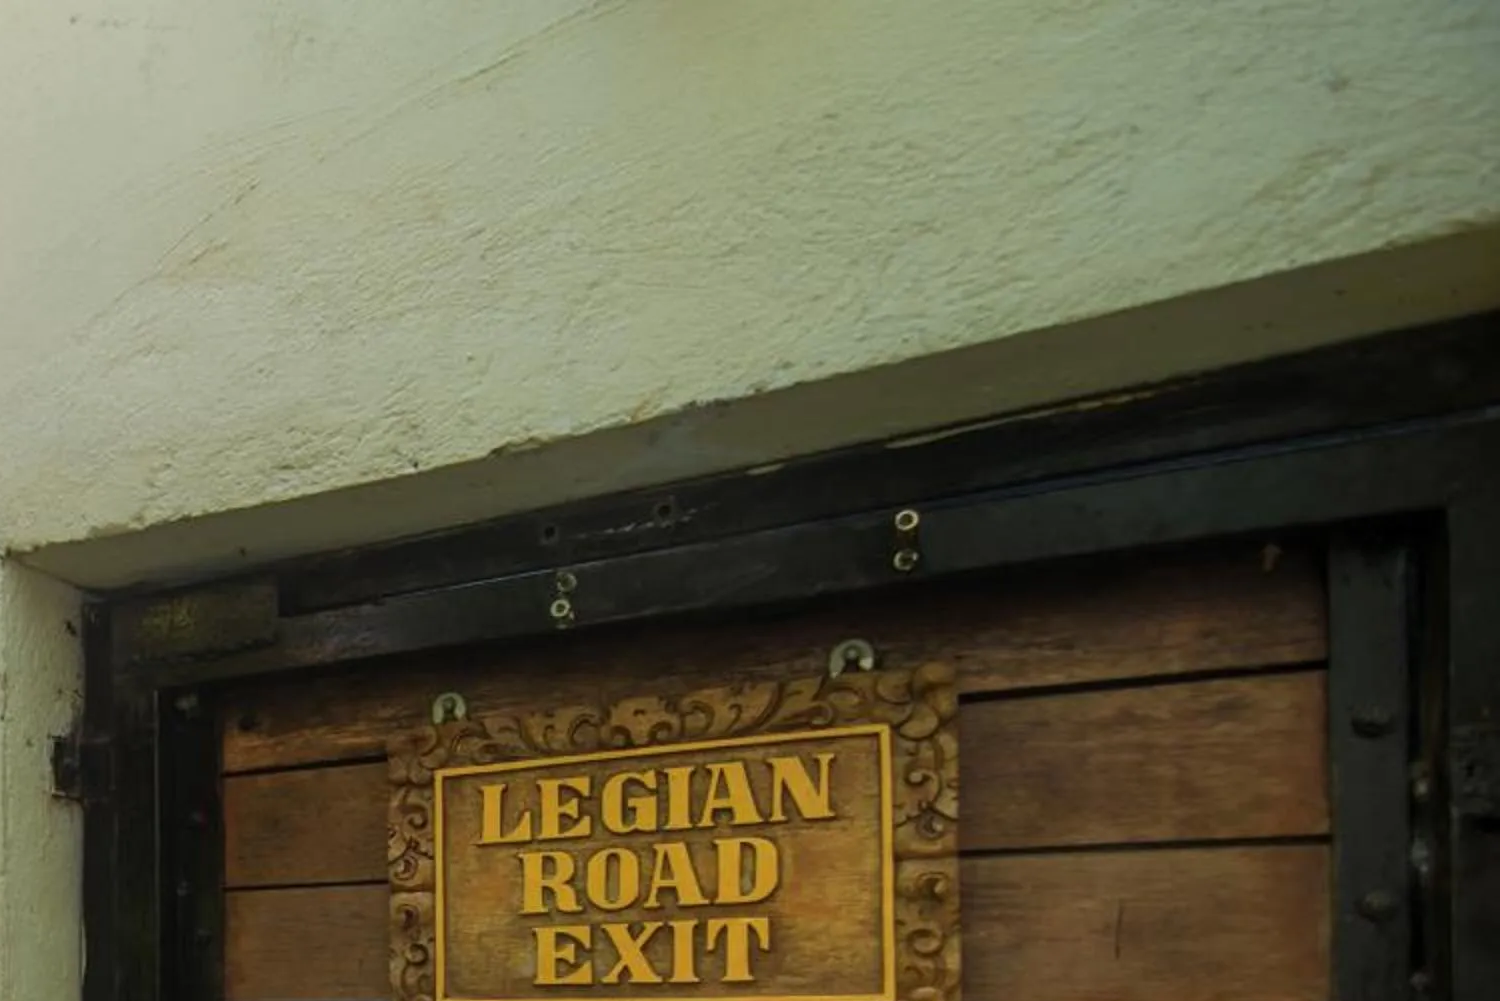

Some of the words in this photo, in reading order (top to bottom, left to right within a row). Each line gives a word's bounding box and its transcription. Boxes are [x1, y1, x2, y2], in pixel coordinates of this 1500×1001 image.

[476, 752, 837, 846] LEGIAN
[518, 836, 781, 916] ROAD
[532, 916, 771, 985] EXIT
